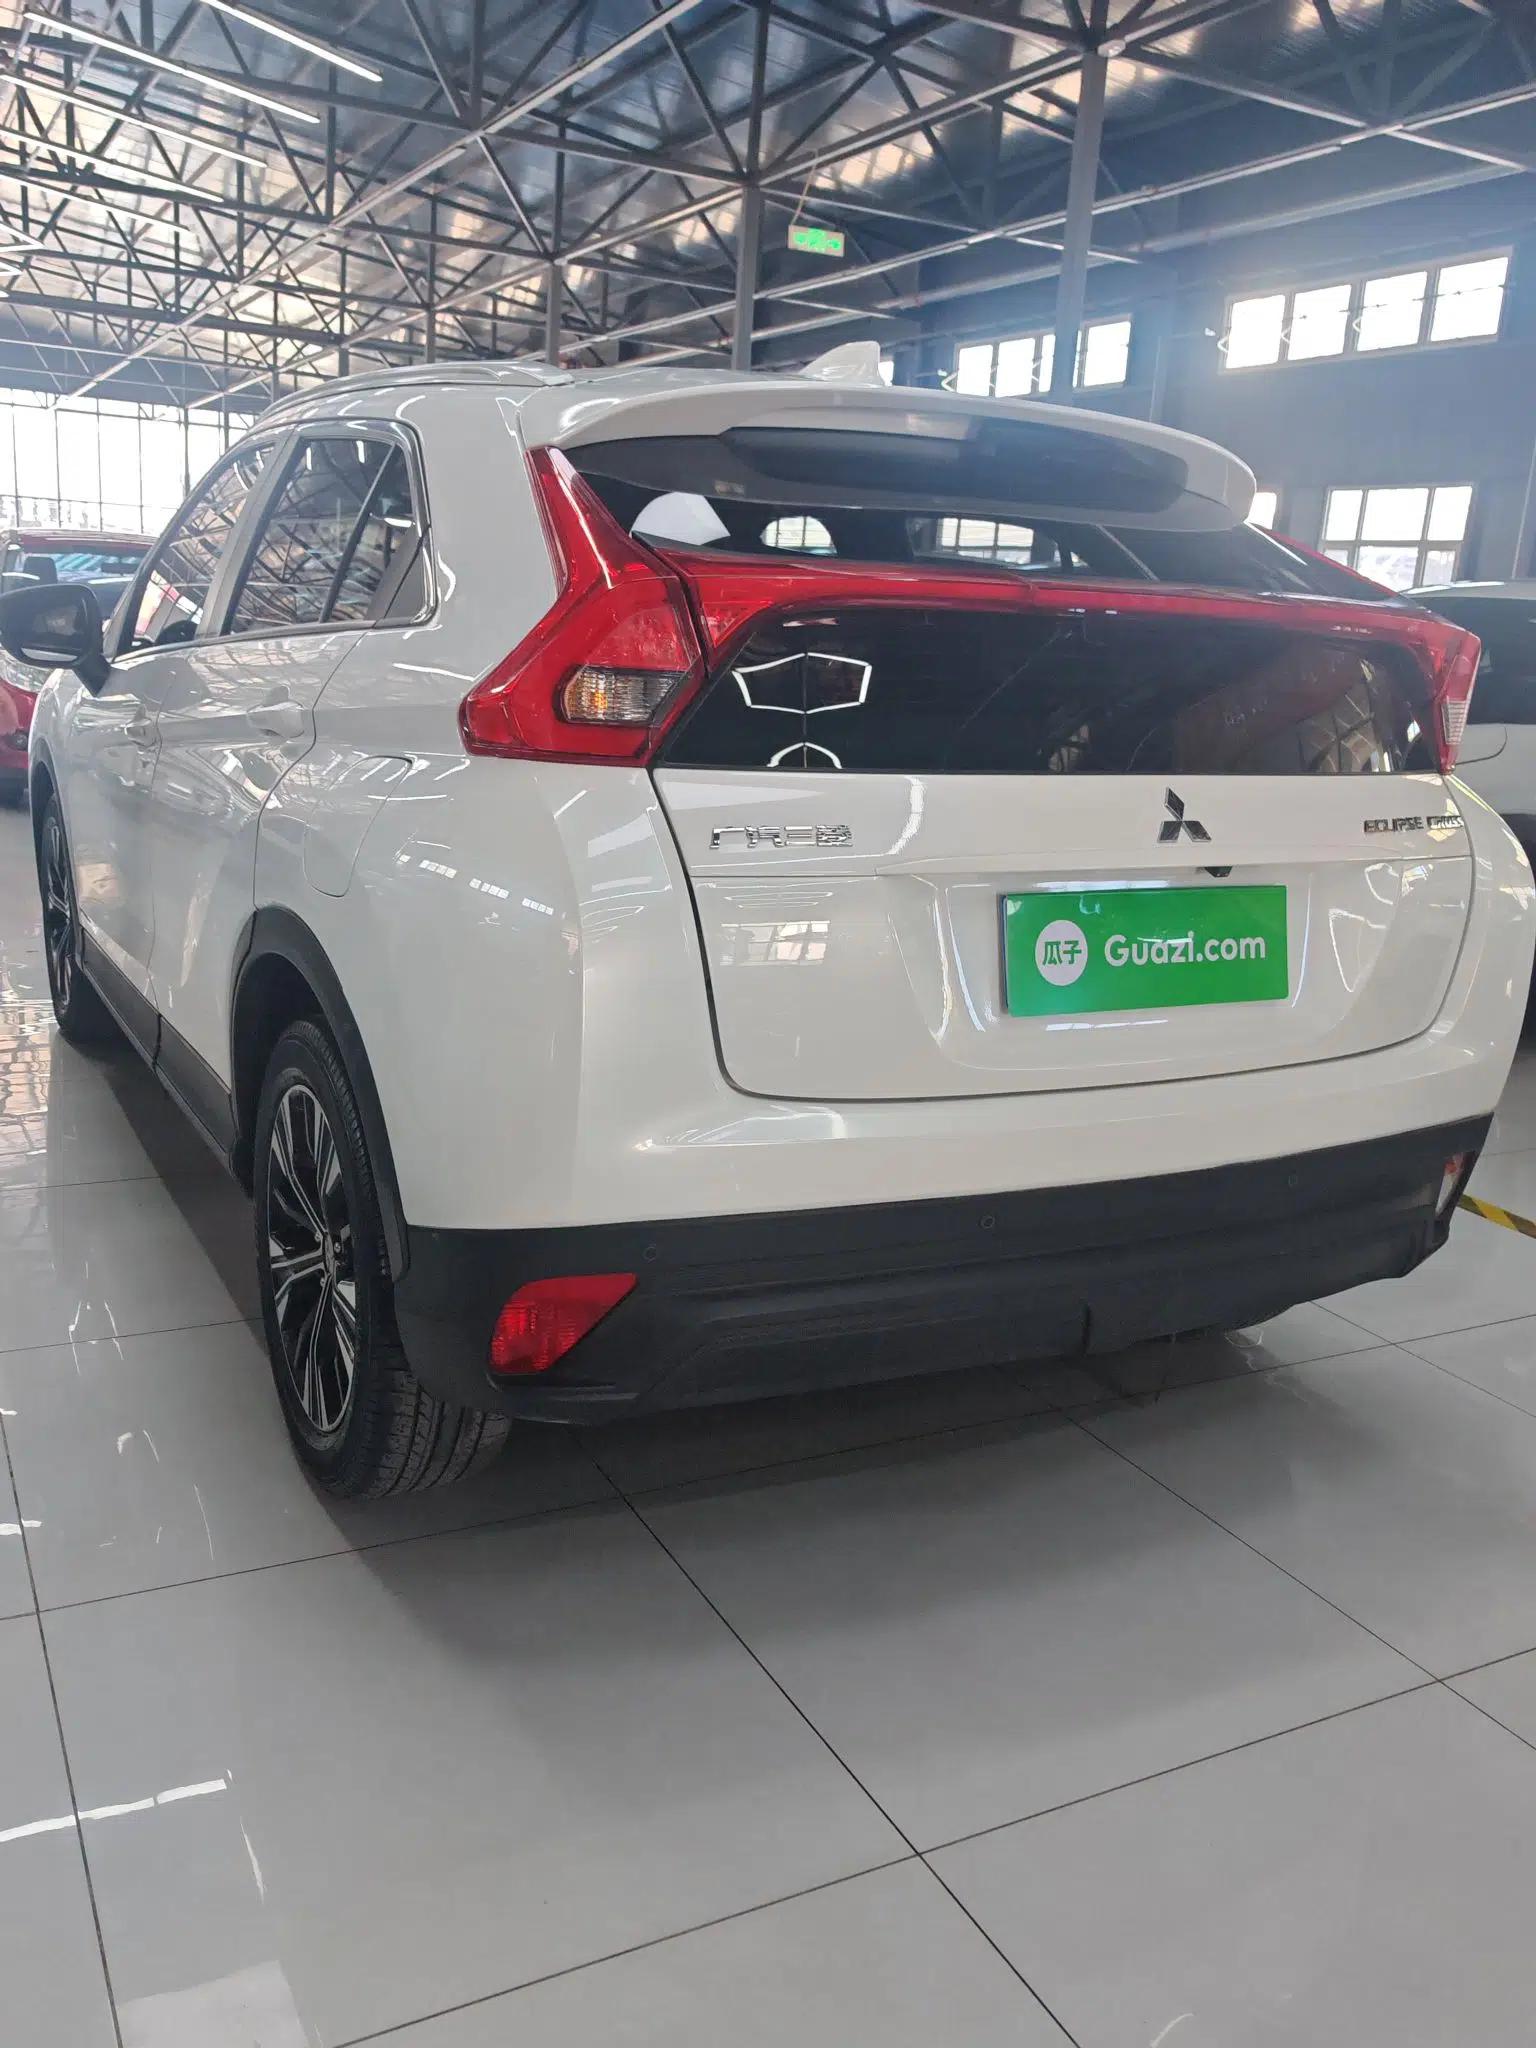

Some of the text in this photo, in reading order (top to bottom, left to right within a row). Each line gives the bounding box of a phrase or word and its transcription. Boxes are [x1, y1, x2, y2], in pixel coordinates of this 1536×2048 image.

[1363, 816, 1424, 833] ECLIPSE
[1042, 939, 1082, 967] 瓜子
[1104, 930, 1266, 967] Guazi.com
